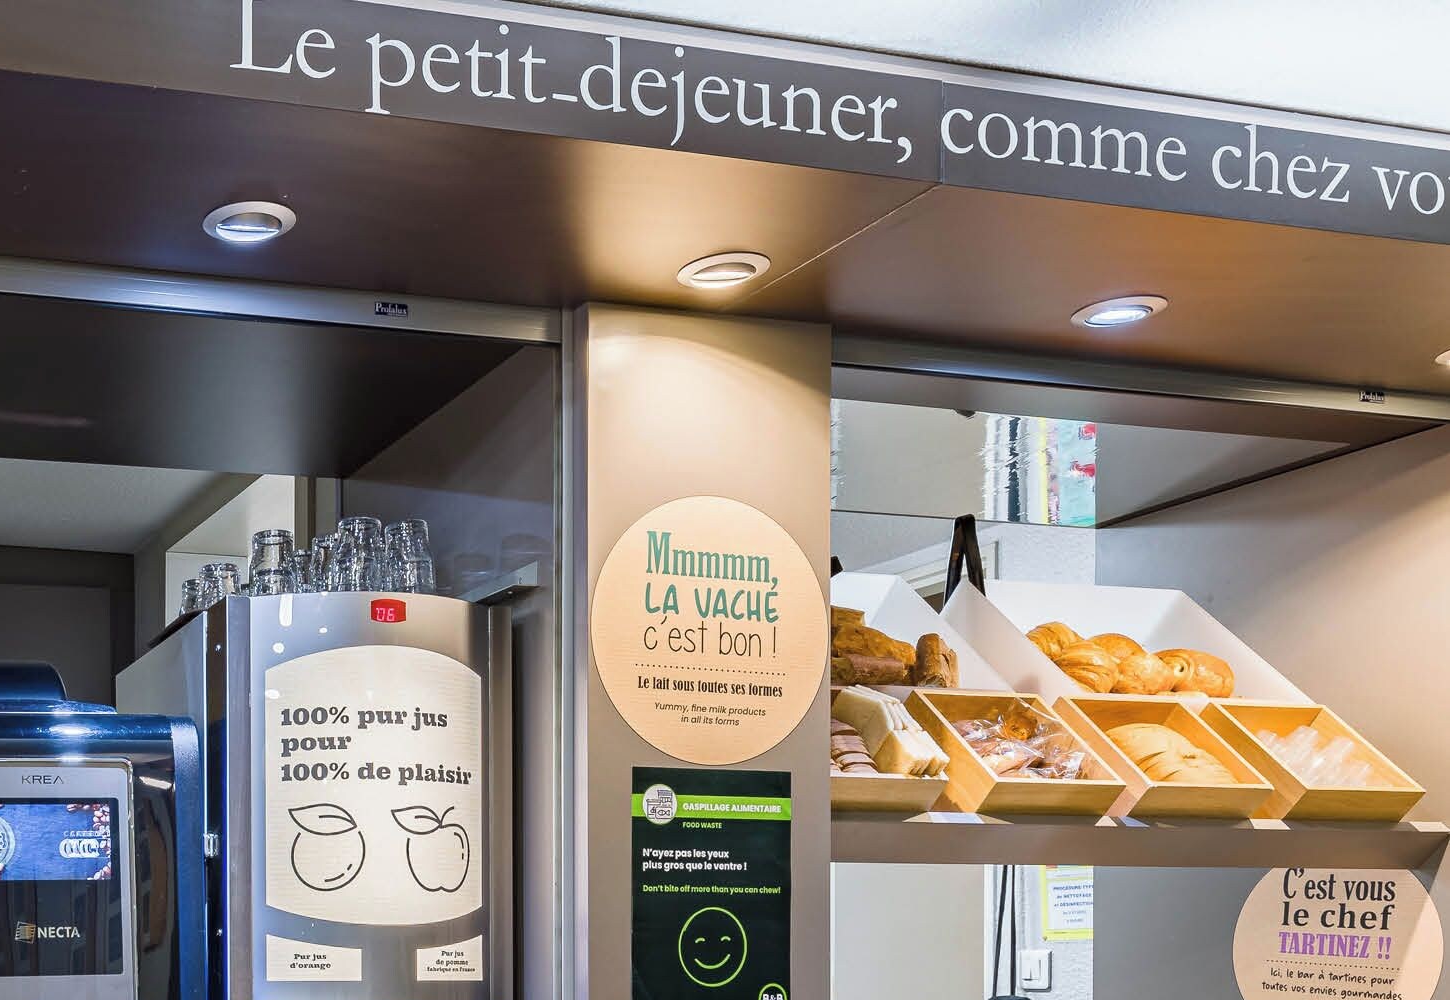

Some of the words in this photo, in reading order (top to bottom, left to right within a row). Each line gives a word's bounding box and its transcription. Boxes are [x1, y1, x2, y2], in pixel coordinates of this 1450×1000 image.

[230, 0, 336, 80] Le
[941, 107, 1187, 182] comme
[1211, 125, 1351, 203] chez
[1371, 166, 1450, 215] vo
[646, 531, 778, 590] Mmmmm,
[645, 582, 680, 614] LA
[694, 588, 780, 623] VACHE
[643, 616, 708, 653] c'est
[719, 622, 762, 657] bon
[772, 626, 777, 658] !
[638, 676, 650, 688] Le
[653, 677, 669, 690] lait
[673, 680, 695, 691] sous
[698, 680, 728, 694] toutes
[731, 683, 746, 695] ses
[749, 682, 783, 697] formes
[281, 706, 349, 726] 100%
[357, 710, 407, 730] pur
[412, 707, 448, 730] jus
[655, 702, 689, 713] Yummy,
[691, 703, 707, 712] fine
[709, 705, 727, 714] milk
[728, 706, 766, 716] products
[681, 715, 689, 723] in
[703, 716, 713, 724] its
[715, 717, 740, 726] forms
[281, 735, 352, 758] pour
[281, 762, 349, 782] 100%
[357, 762, 391, 781] de
[398, 763, 472, 786] plaisir
[731, 803, 782, 813] ALIMENTAIRE
[642, 848, 674, 860] N'ayez
[675, 850, 692, 860] pas
[693, 849, 706, 858] les
[707, 850, 730, 860] yeux
[642, 860, 663, 871] plus
[664, 862, 685, 872] gros
[685, 863, 703, 872] que
[704, 861, 712, 870] le
[713, 862, 743, 871] ventre
[642, 884, 663, 892] Don't
[680, 885, 690, 893] off
[711, 885, 729, 893] than
[730, 887, 744, 895] you
[1283, 868, 1337, 901] C'est
[1343, 879, 1396, 901] vous
[1281, 901, 1310, 926] le
[1320, 902, 1395, 930] chef
[37, 926, 80, 938] NECTA
[1278, 932, 1370, 958] TARTINEZ
[1377, 936, 1392, 960] !!
[290, 962, 331, 970] d'orange
[312, 953, 327, 961] jus
[1270, 968, 1283, 978] Ici,
[1286, 968, 1294, 978] le
[1297, 970, 1315, 979] bar
[1318, 970, 1325, 980] à
[1328, 972, 1367, 984] tartines
[1370, 976, 1395, 987] pour
[1261, 982, 1288, 991] toutes
[1291, 985, 1306, 993] vos
[1309, 986, 1337, 996] envies
[1340, 989, 1402, 1000] gourmandes
